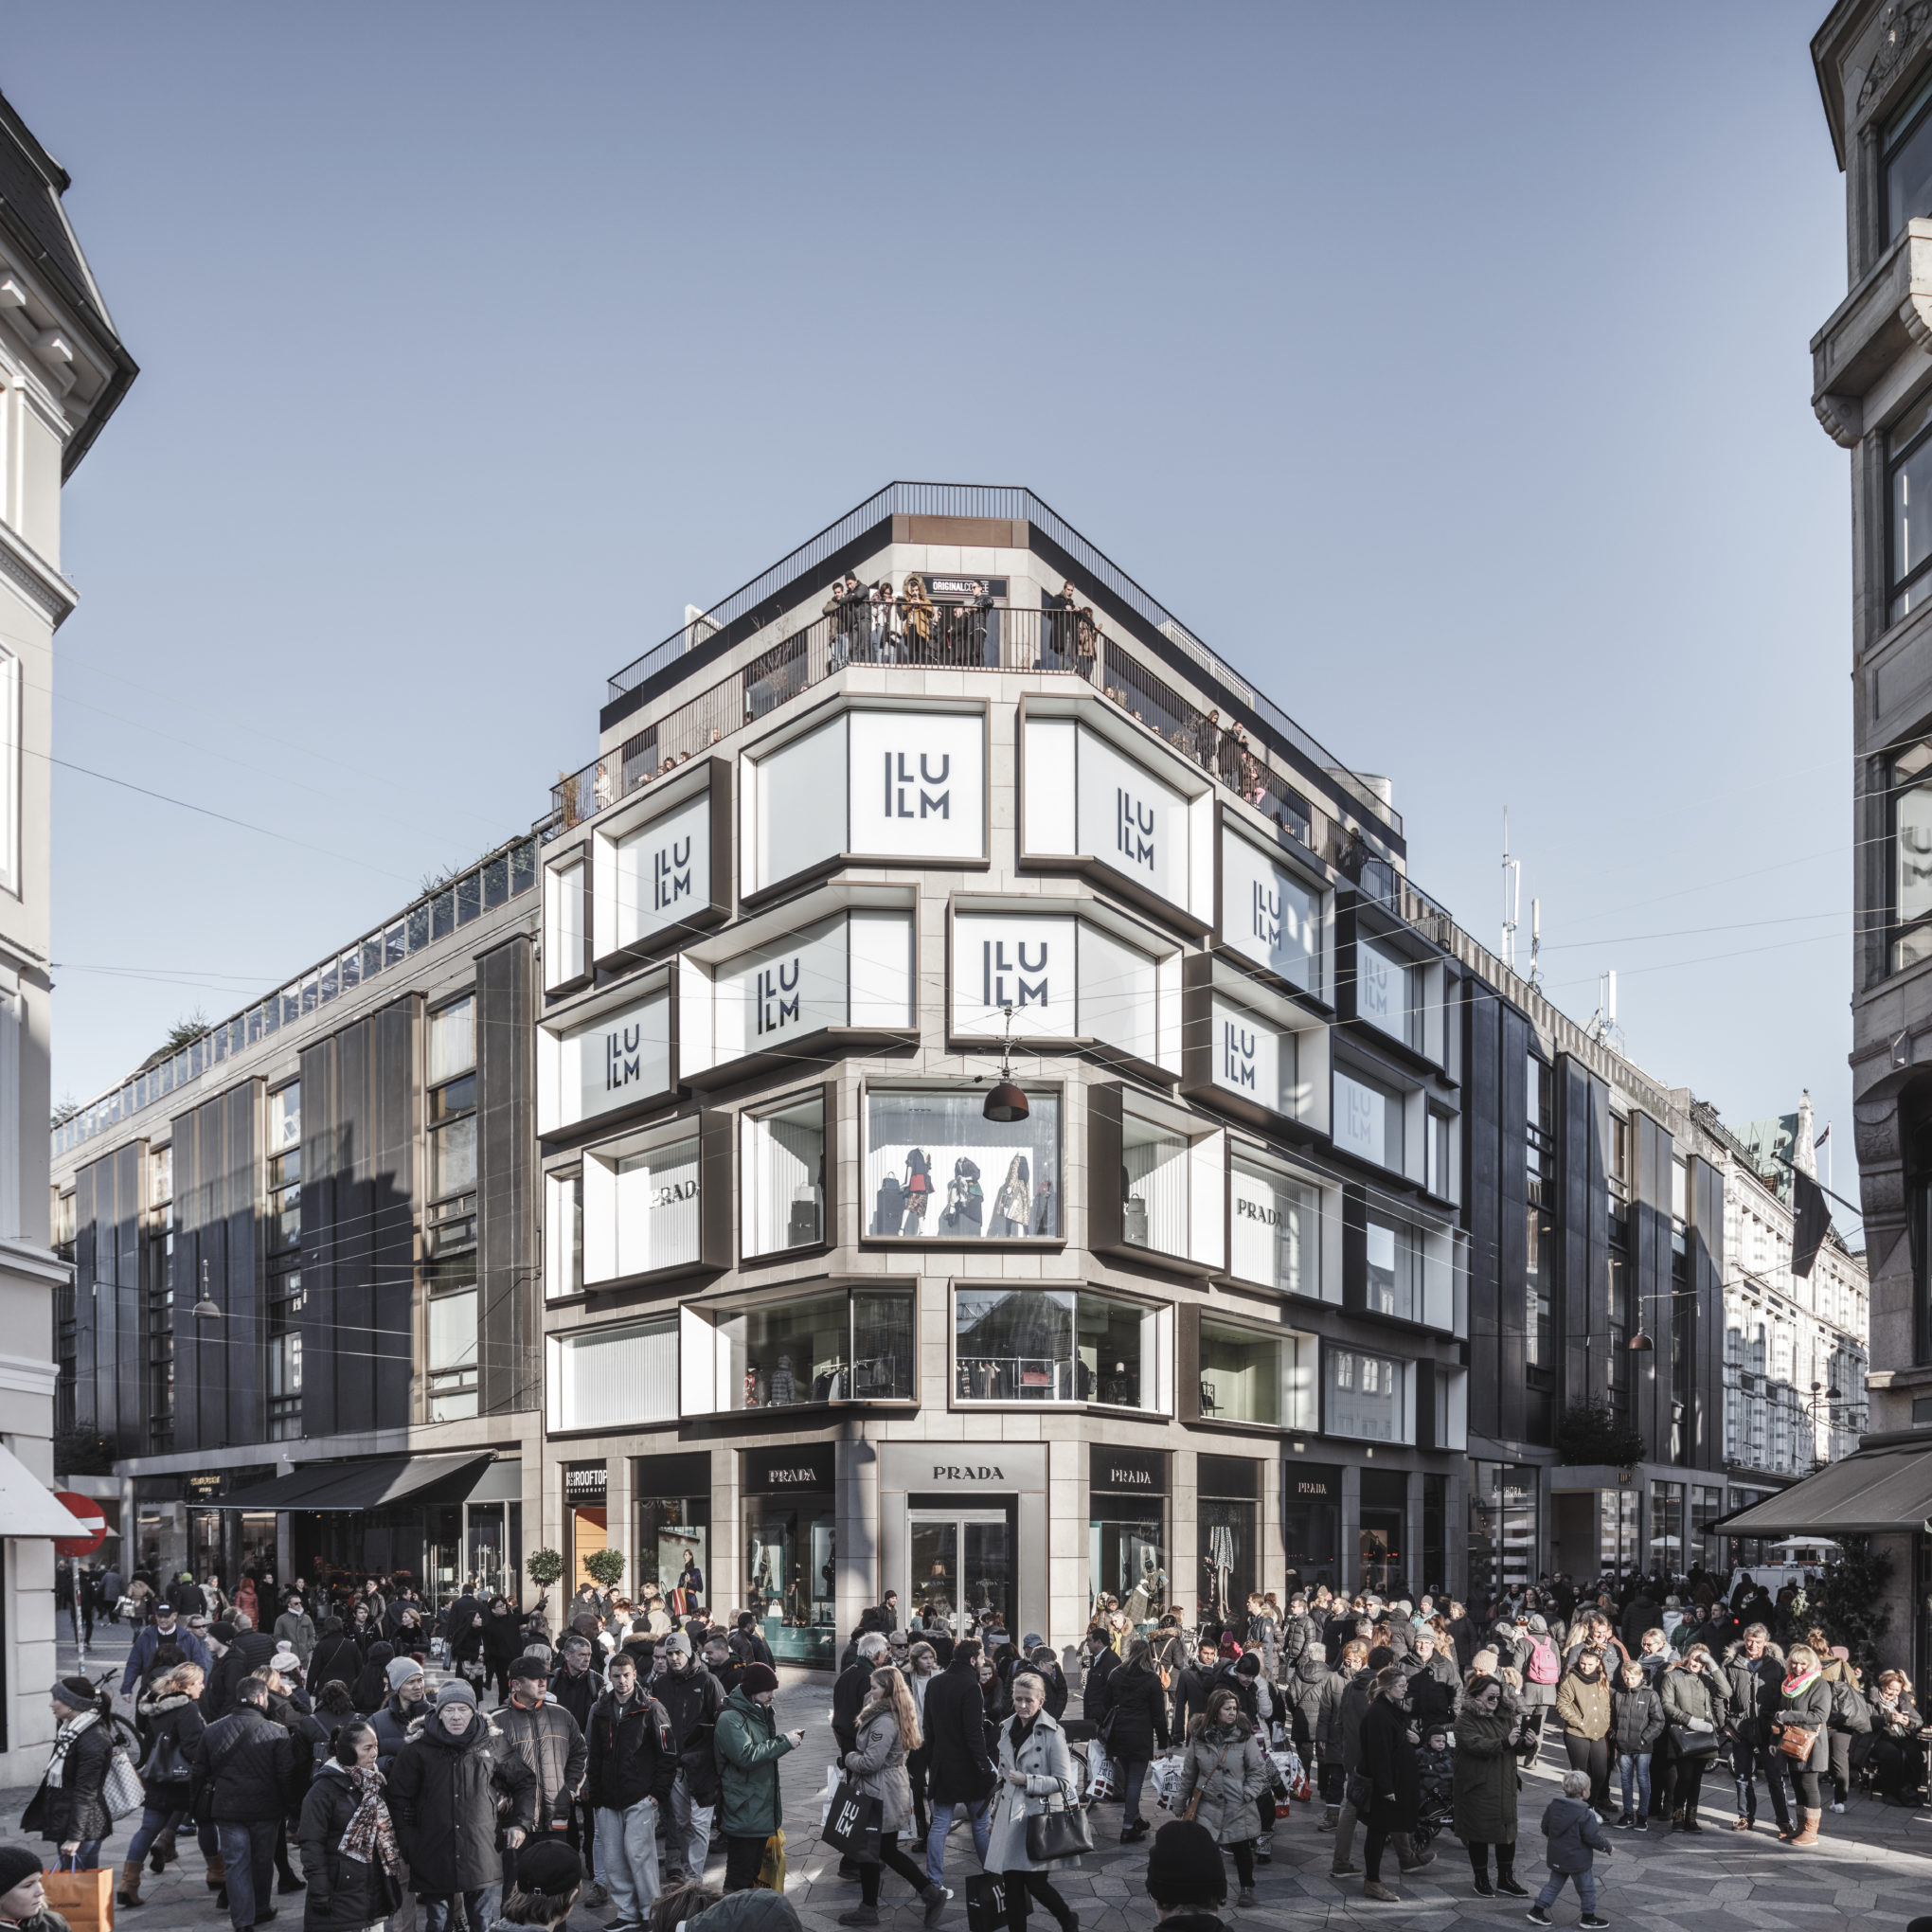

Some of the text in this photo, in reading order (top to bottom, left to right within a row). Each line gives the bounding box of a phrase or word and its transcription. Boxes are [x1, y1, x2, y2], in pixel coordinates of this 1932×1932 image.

[575, 1470, 607, 1486] ROOFTOP
[768, 1469, 817, 1483] PRADA
[933, 1466, 1005, 1480] PRADA
[1111, 1469, 1152, 1484] PRADA
[1297, 1482, 1327, 1494] PRADA
